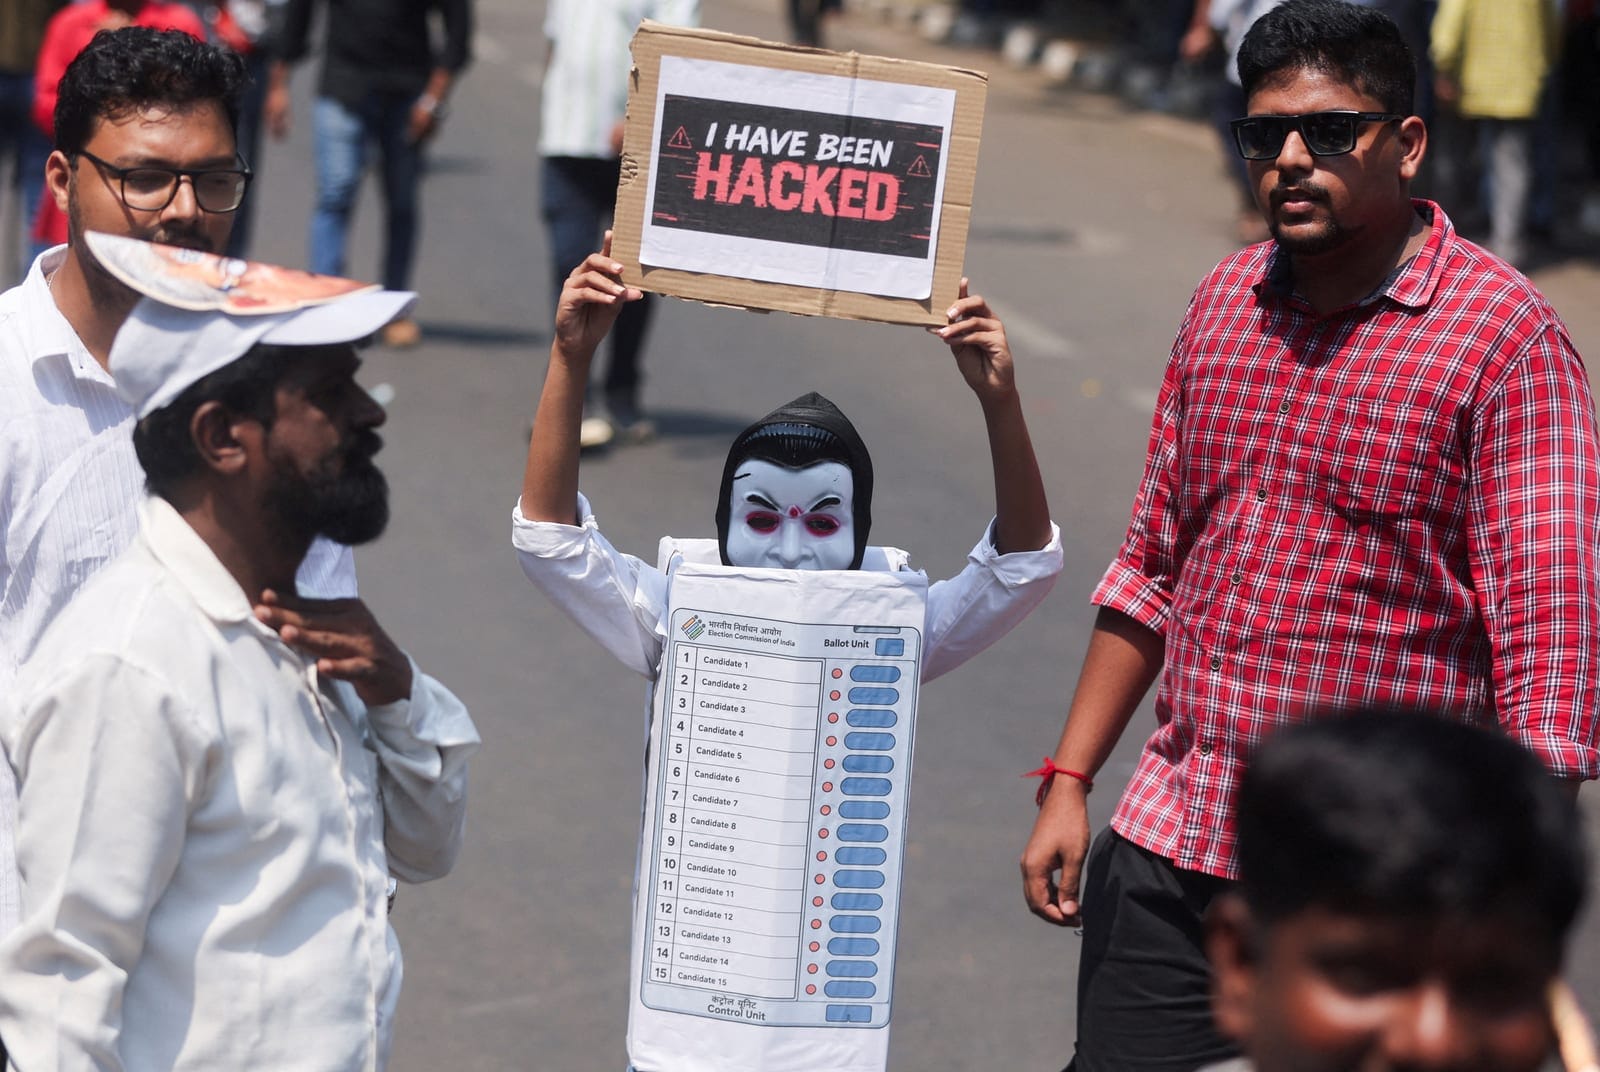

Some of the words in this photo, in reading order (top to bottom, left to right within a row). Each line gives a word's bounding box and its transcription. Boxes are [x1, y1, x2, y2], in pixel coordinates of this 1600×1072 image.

[705, 122, 718, 148] I
[724, 124, 809, 156] HAVE
[814, 133, 894, 168] BEEN
[694, 151, 900, 222] HACKED
[708, 630, 733, 639] Election
[735, 633, 771, 643] Commission
[780, 639, 795, 647] India
[824, 639, 849, 647] Ballot
[851, 640, 869, 648] Unit
[684, 653, 689, 663] 1
[704, 656, 742, 667] Candidate
[745, 662, 749, 670] 1
[681, 675, 689, 686] 2
[702, 679, 740, 689] Candidate
[679, 698, 687, 709] 3
[700, 701, 738, 712] Candidate
[741, 706, 746, 714] 3
[677, 721, 685, 732] 4
[698, 725, 736, 736] Candidate
[676, 744, 683, 754] 5
[697, 747, 735, 758] Candidate
[737, 752, 743, 760] 5
[673, 767, 681, 778] 6
[695, 770, 733, 781] Candidate
[735, 776, 741, 784] 6
[672, 790, 679, 801] 7
[693, 794, 731, 805] Candidate
[670, 813, 677, 824] 8
[691, 817, 728, 828] Candidate
[668, 836, 676, 847] 9
[689, 840, 727, 851] Candidate
[729, 845, 735, 853] 9
[664, 859, 677, 870] 10
[687, 863, 725, 875] Candidate
[728, 869, 737, 877] 10
[663, 880, 673, 892] 11
[685, 884, 723, 896] Candidate
[727, 890, 734, 898] 11
[661, 903, 673, 914] 12
[684, 907, 721, 918] Candidate
[725, 913, 734, 921] 12
[659, 926, 671, 937] 13
[681, 929, 720, 942] Candidate
[722, 936, 732, 944] 13
[657, 948, 669, 959] 14
[680, 952, 717, 963] Candidate
[720, 958, 729, 966] 14
[656, 968, 668, 979] 15
[677, 972, 716, 984] Candidate
[718, 979, 727, 987] 15
[707, 1005, 743, 1017] Control
[746, 1010, 766, 1020] Unit
